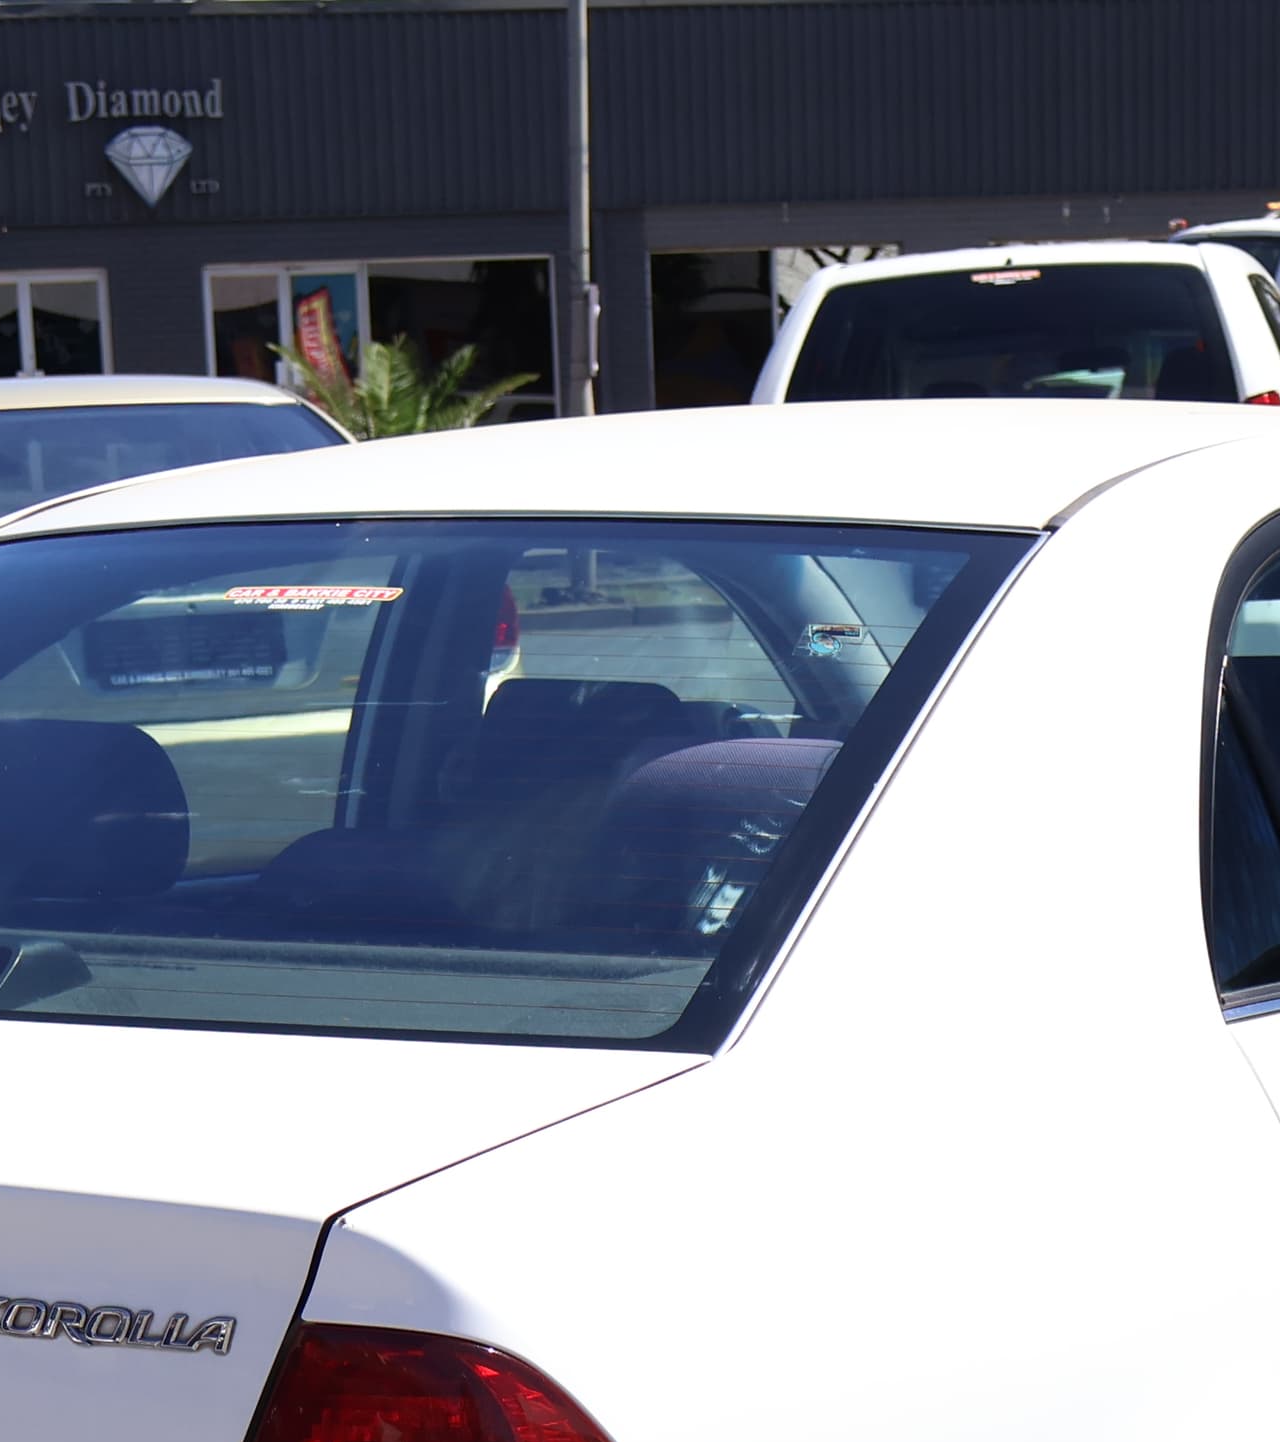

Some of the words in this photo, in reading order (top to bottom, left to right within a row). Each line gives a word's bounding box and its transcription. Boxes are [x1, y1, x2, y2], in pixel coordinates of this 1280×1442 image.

[63, 78, 225, 123] Diamond
[229, 588, 263, 598] CAR
[266, 588, 279, 598] &
[284, 588, 348, 598] BAKKIE
[357, 588, 397, 599] CITY
